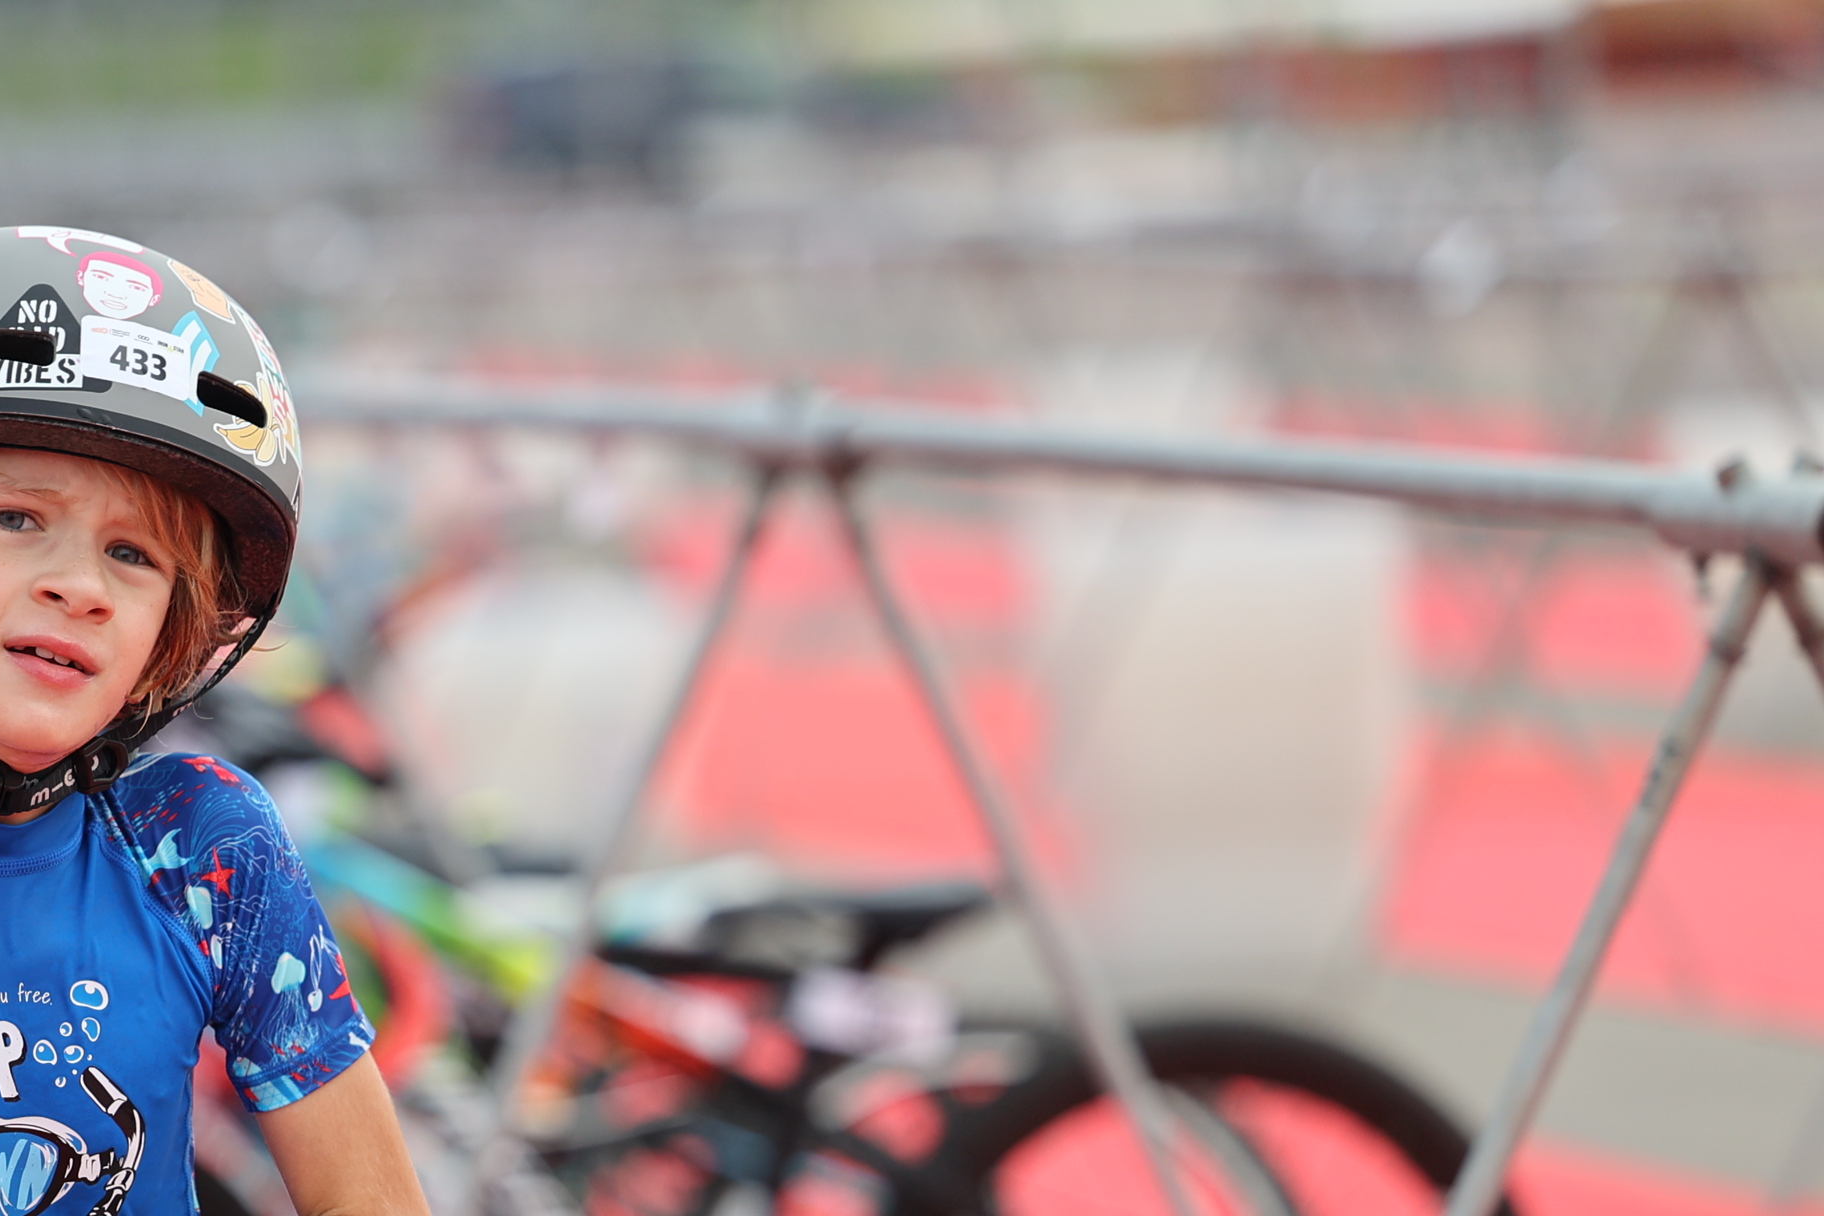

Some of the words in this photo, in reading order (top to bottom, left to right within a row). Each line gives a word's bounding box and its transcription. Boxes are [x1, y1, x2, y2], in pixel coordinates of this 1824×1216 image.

[18, 299, 58, 324] NO
[109, 344, 167, 382] 433
[17, 982, 53, 1006] free.
